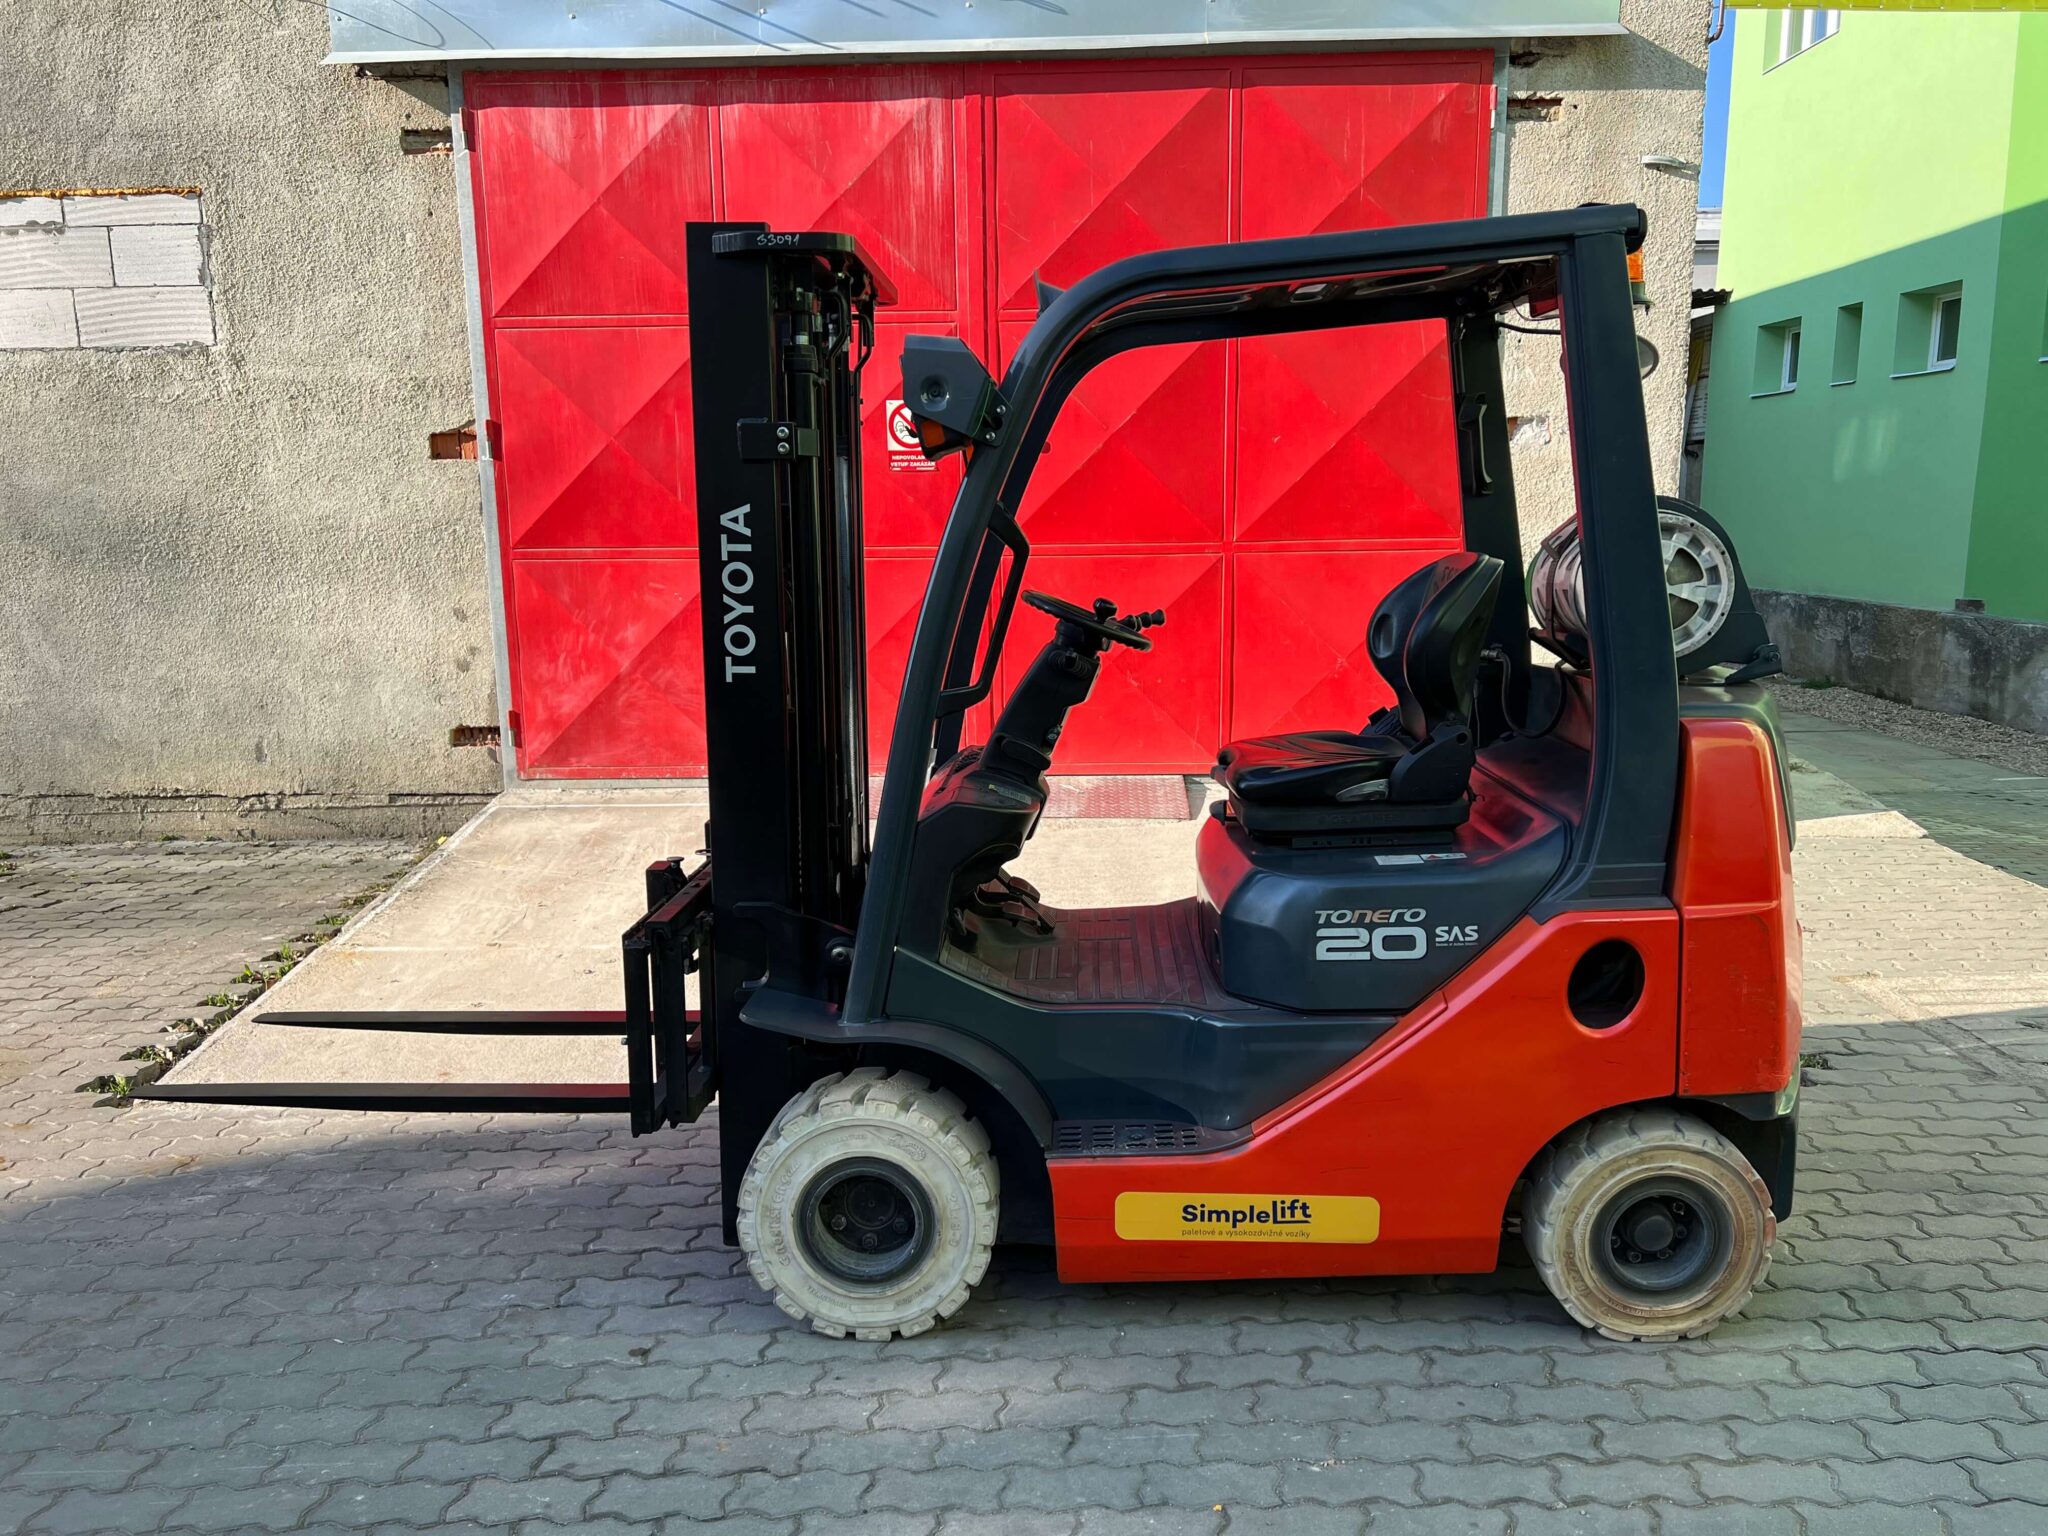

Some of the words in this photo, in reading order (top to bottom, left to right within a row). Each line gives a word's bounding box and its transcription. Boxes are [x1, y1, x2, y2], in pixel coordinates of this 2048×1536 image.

[719, 503, 757, 683] TOYOTA
[1316, 926, 1427, 961] 20
[1435, 925, 1479, 942] SAS
[1181, 1227, 1216, 1237] paletové
[1225, 1228, 1283, 1238] vysokozdvižné
[1285, 1230, 1311, 1239] vozíky
